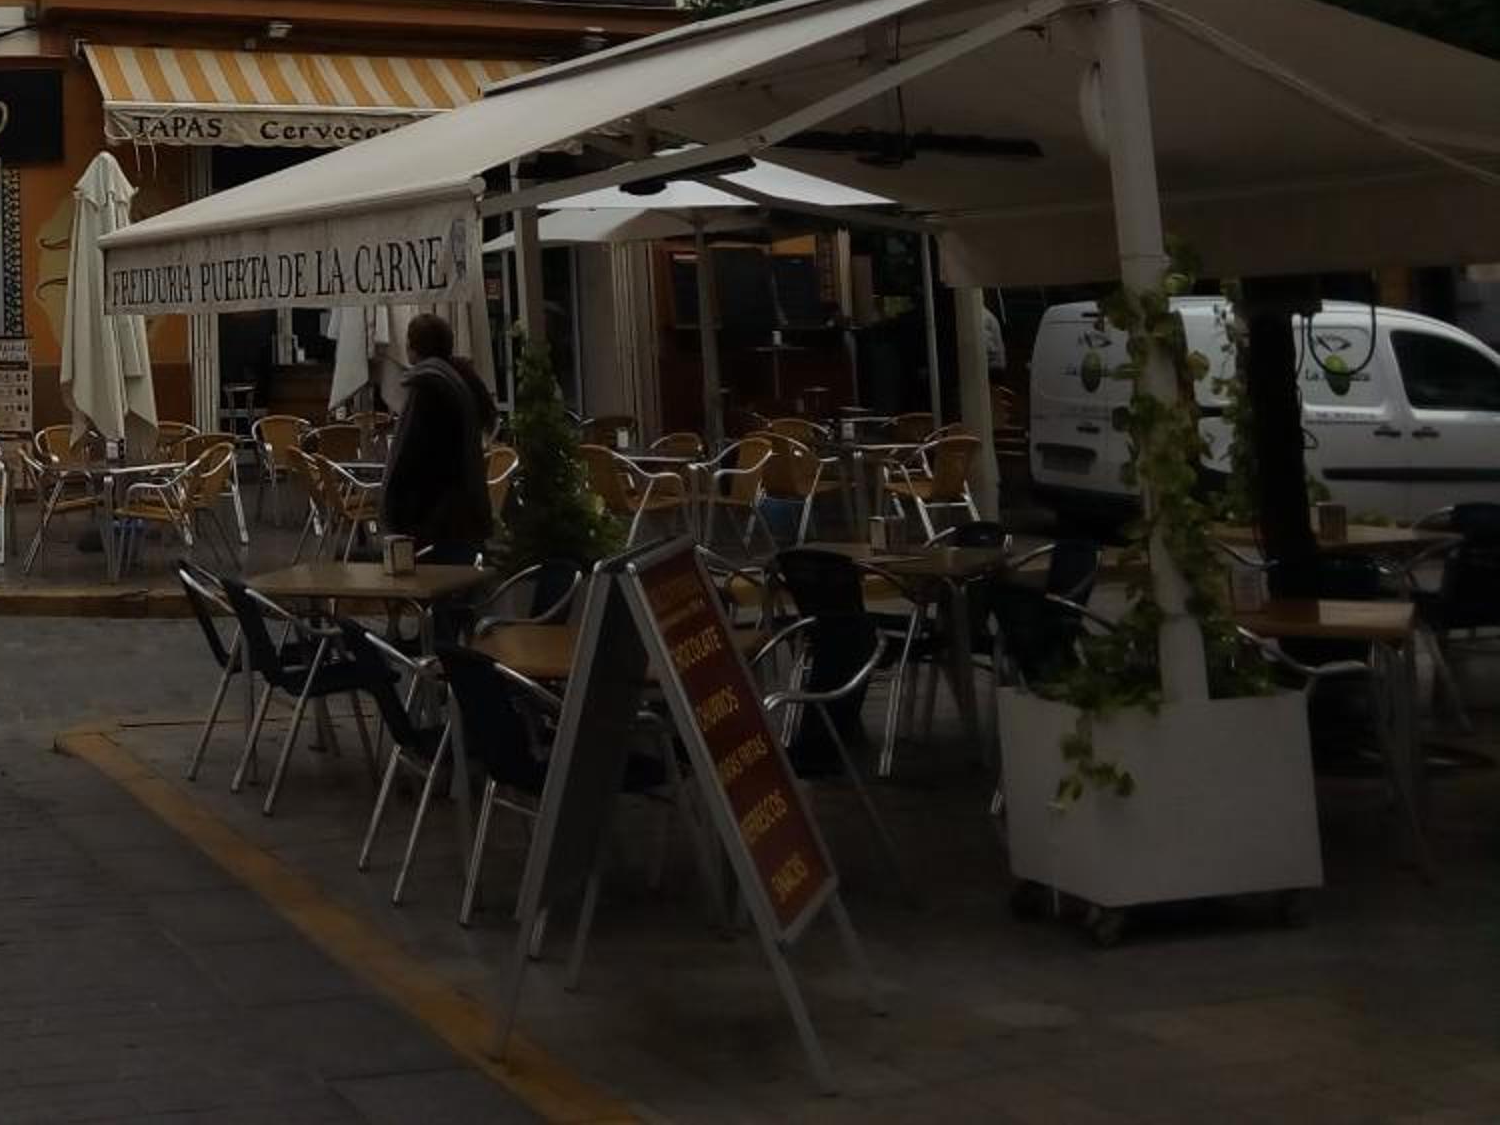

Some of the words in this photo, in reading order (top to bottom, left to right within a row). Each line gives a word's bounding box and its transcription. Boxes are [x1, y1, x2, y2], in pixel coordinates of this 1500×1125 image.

[132, 116, 223, 139] TAPAS
[201, 255, 273, 303] PUERTA
[277, 252, 307, 298] DE
[315, 250, 346, 296] LA
[355, 236, 448, 294] CARNE
